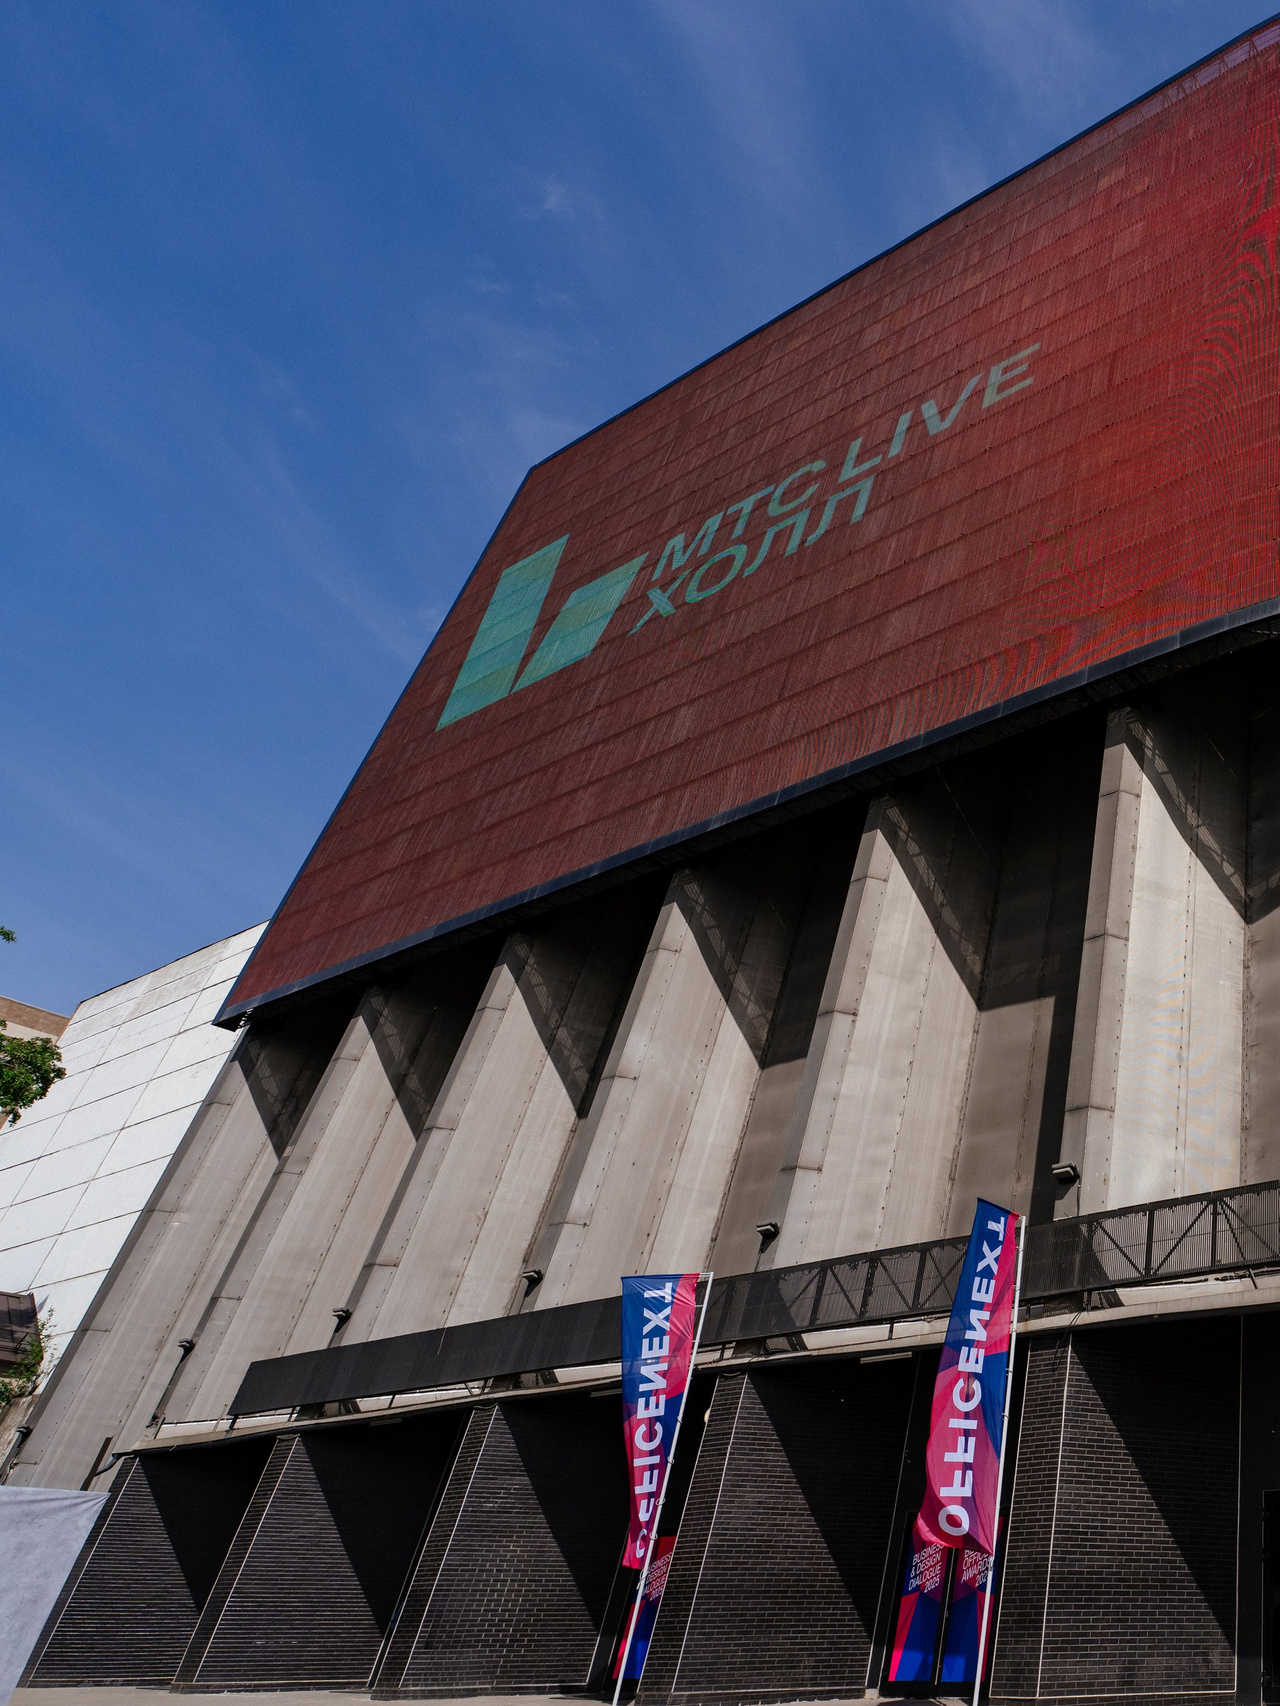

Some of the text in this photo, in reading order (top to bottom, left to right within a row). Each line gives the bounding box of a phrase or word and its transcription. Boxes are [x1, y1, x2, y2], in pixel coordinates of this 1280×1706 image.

[837, 341, 1042, 485] LIVE
[626, 473, 877, 638] ХОЛЛ
[916, 1550, 942, 1575] DESIGN
[908, 1562, 942, 1591] DIALOGUE
[923, 1574, 941, 1594] 2025
[975, 1570, 989, 1587] 202
